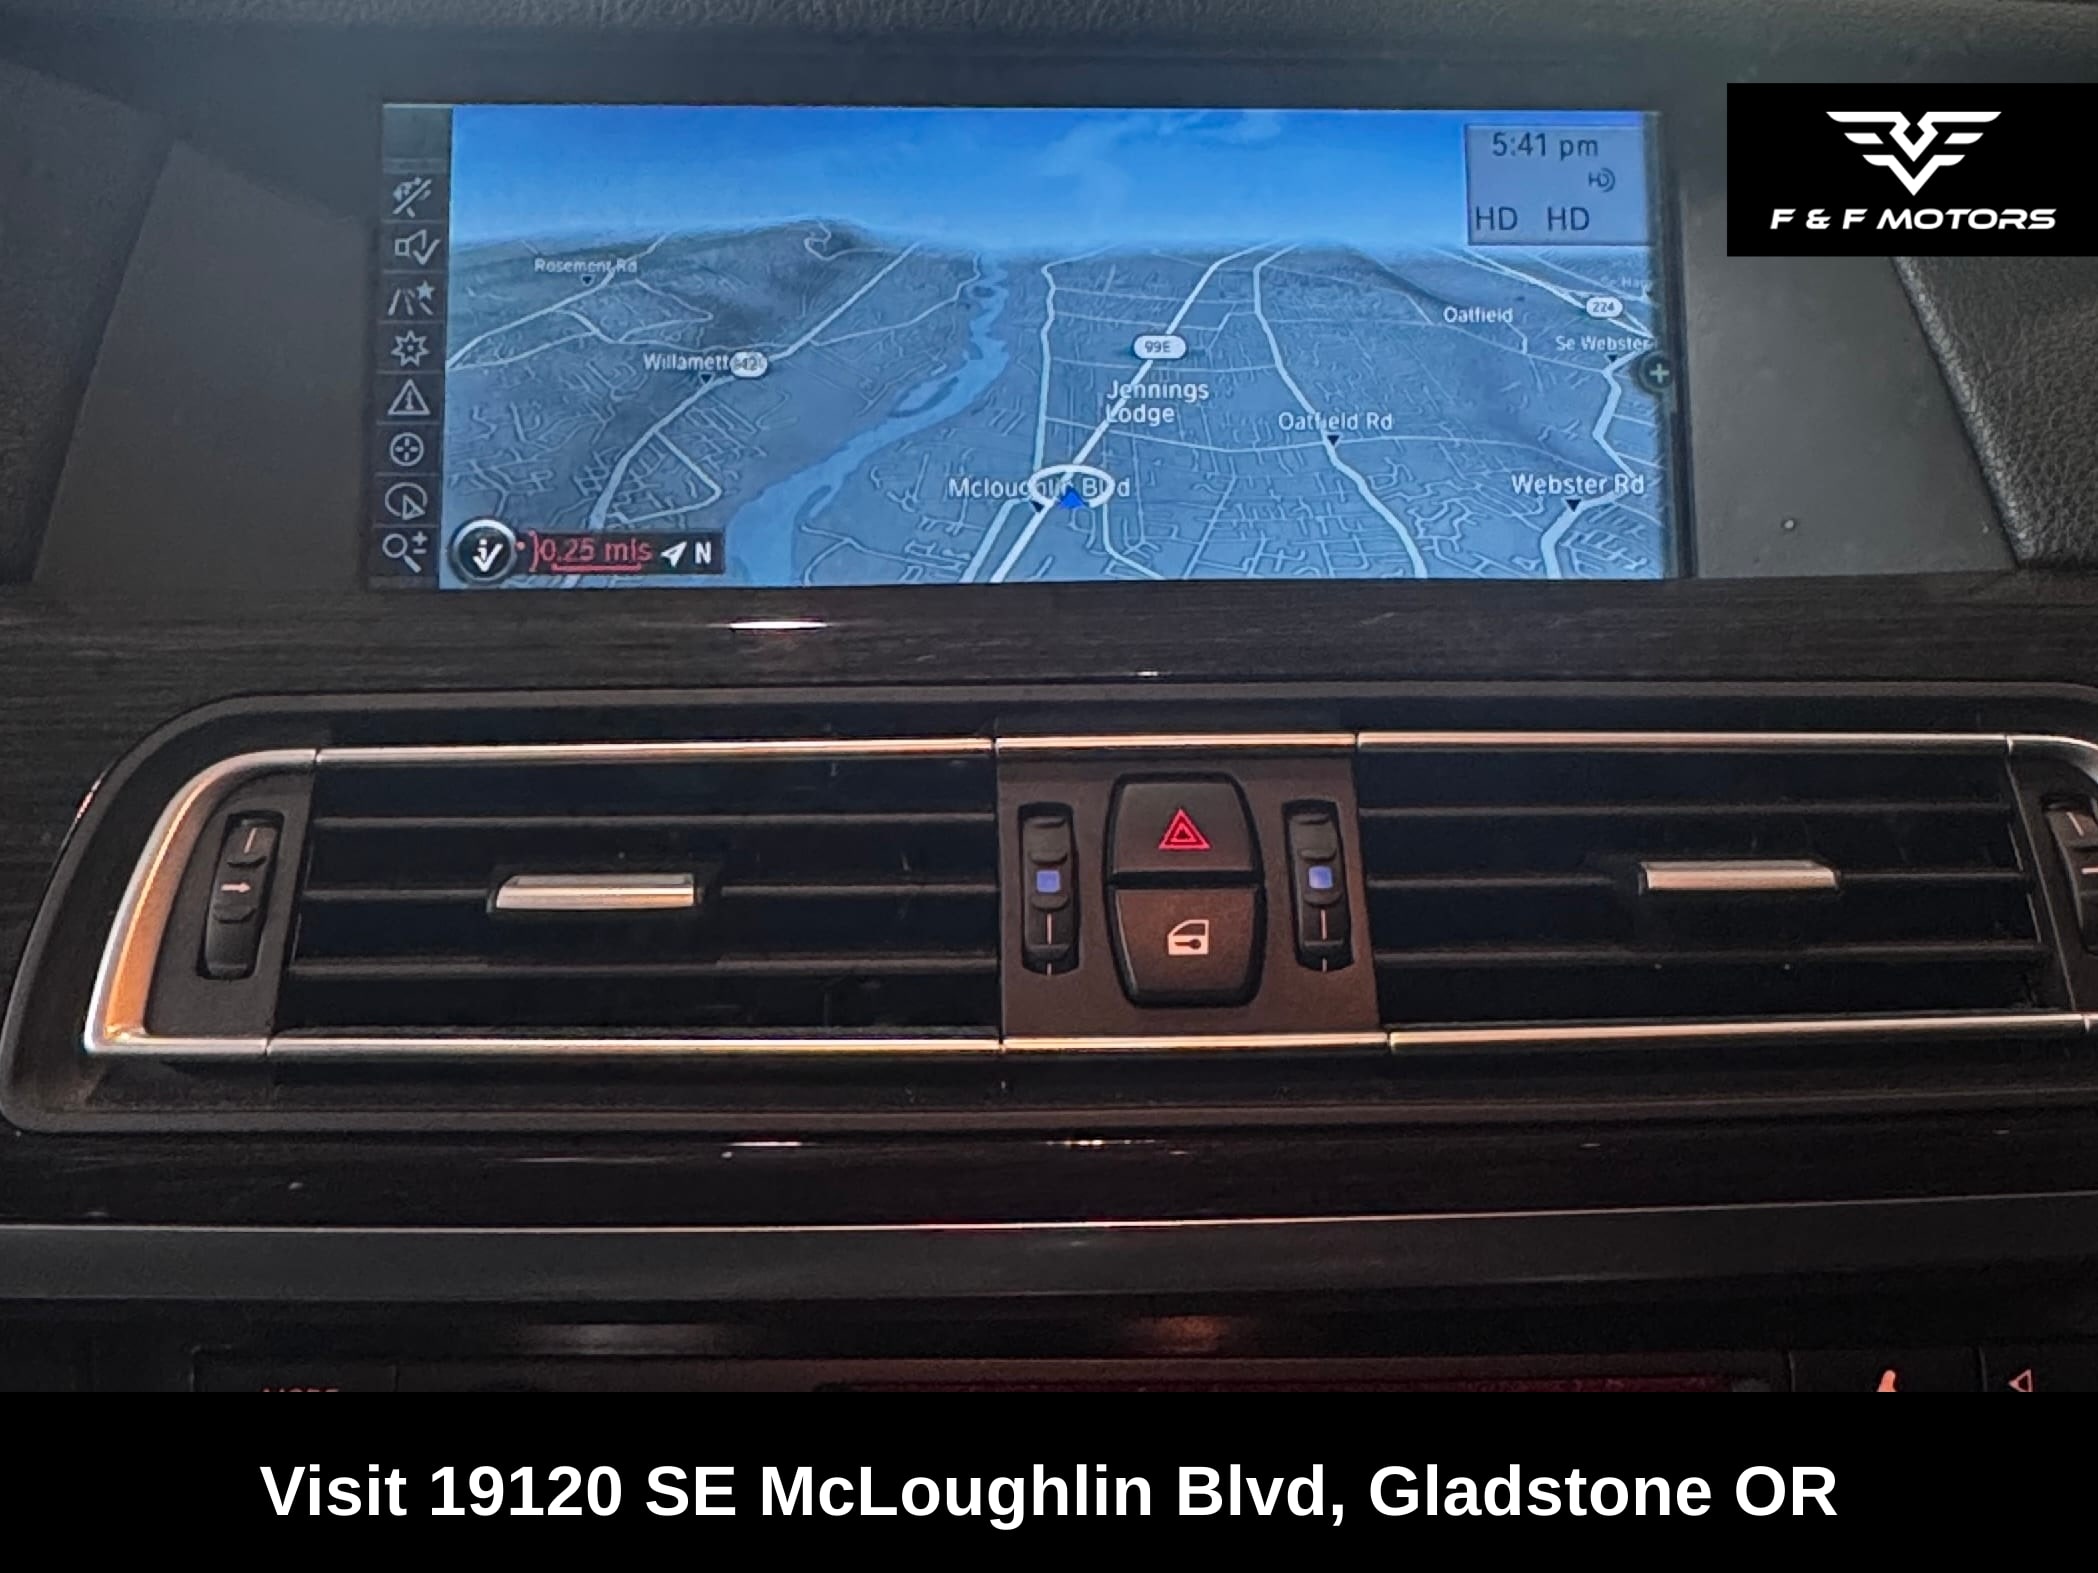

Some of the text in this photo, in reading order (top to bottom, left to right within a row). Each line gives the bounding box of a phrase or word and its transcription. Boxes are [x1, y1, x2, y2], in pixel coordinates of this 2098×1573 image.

[1491, 132, 1599, 161] 5:41 pm
[1475, 206, 1518, 231] HD
[1547, 206, 1590, 231] HD
[616, 257, 638, 273] Rd
[1443, 305, 1513, 324] Oatfield
[1592, 301, 1615, 313] 224
[1144, 339, 1171, 354] 99E
[1106, 380, 1209, 402] Jennings
[1105, 405, 1175, 426] Lodge
[1278, 411, 1393, 432] Oatfield Rd
[1511, 474, 1645, 496] Webster Rd
[539, 538, 595, 562] 0.25
[694, 542, 712, 564] N
